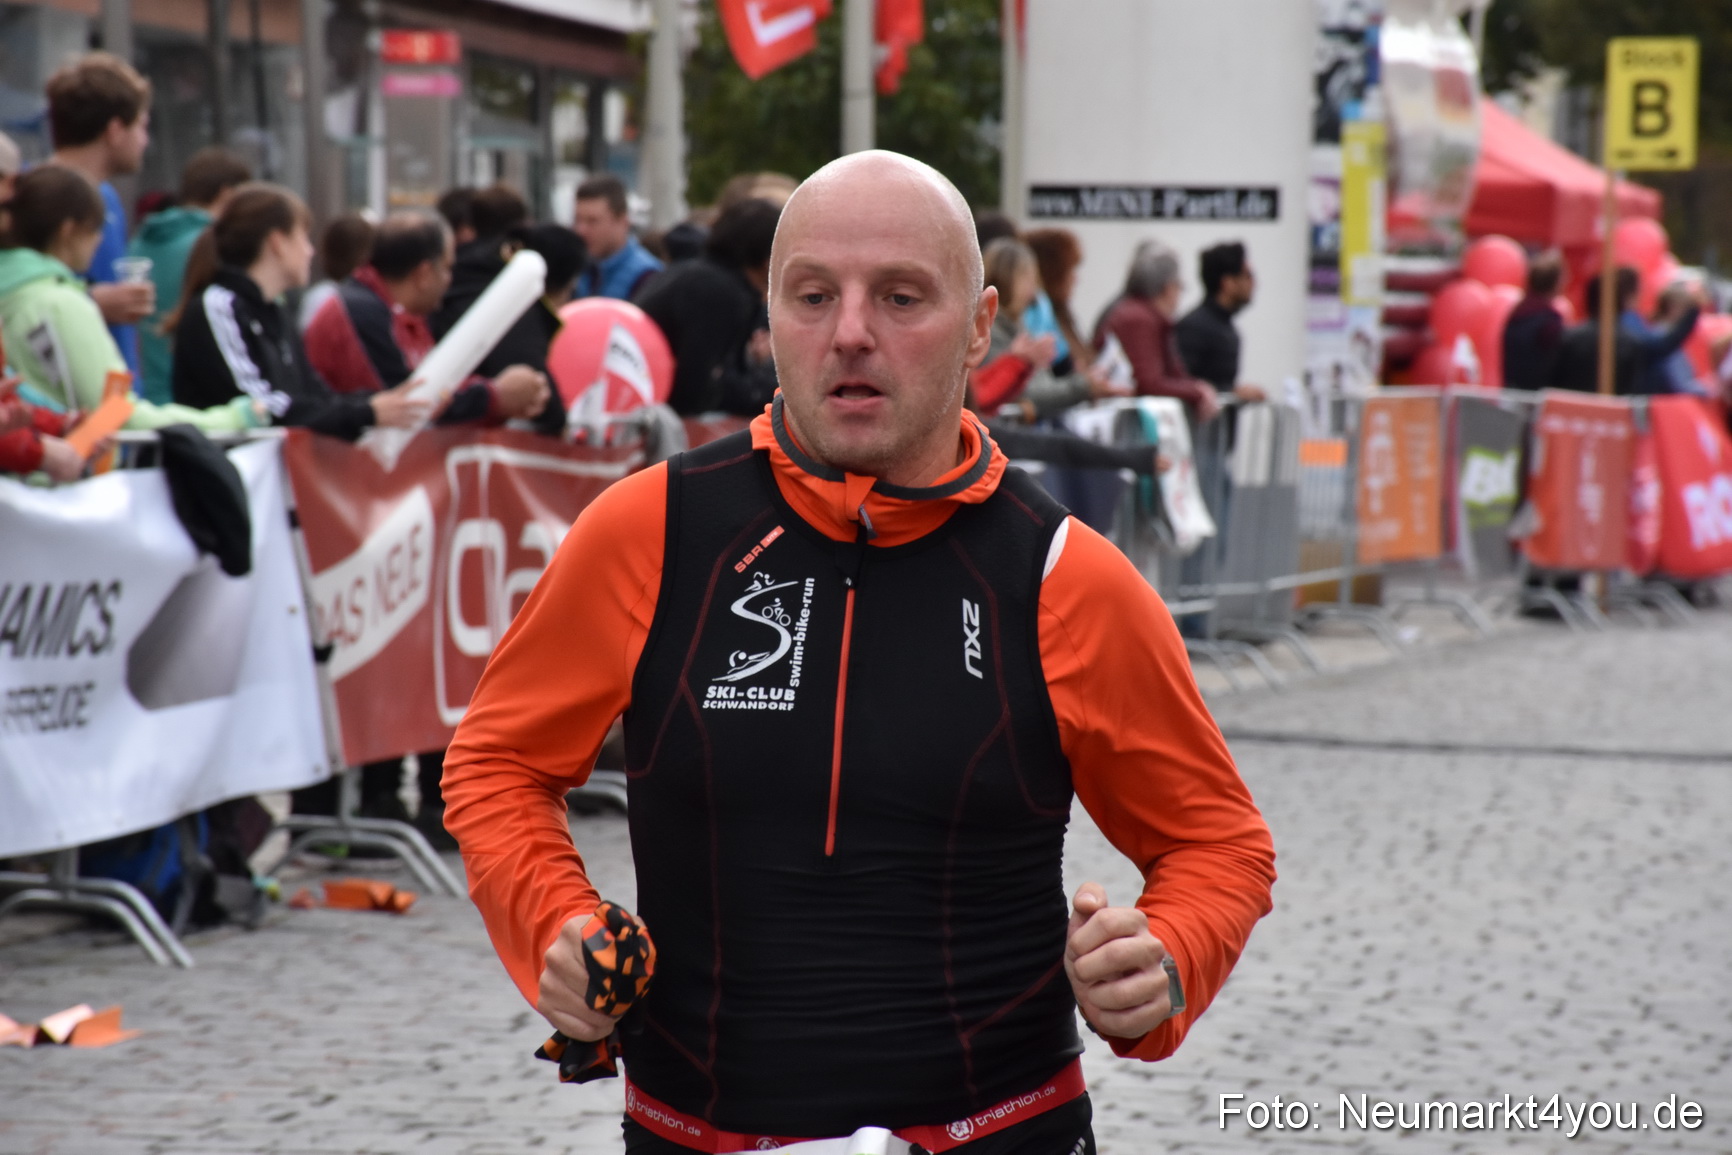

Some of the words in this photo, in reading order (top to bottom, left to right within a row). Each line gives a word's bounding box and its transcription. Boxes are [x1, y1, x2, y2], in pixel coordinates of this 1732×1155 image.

[1631, 80, 1671, 138] B
[734, 544, 764, 573] SBR
[962, 598, 983, 679] 2XU
[702, 700, 795, 712] SCHWANDORF
[706, 685, 796, 702] SKI-CLUB
[636, 1101, 702, 1137] triathlon.de
[974, 1085, 1057, 1127] triathlon.de
